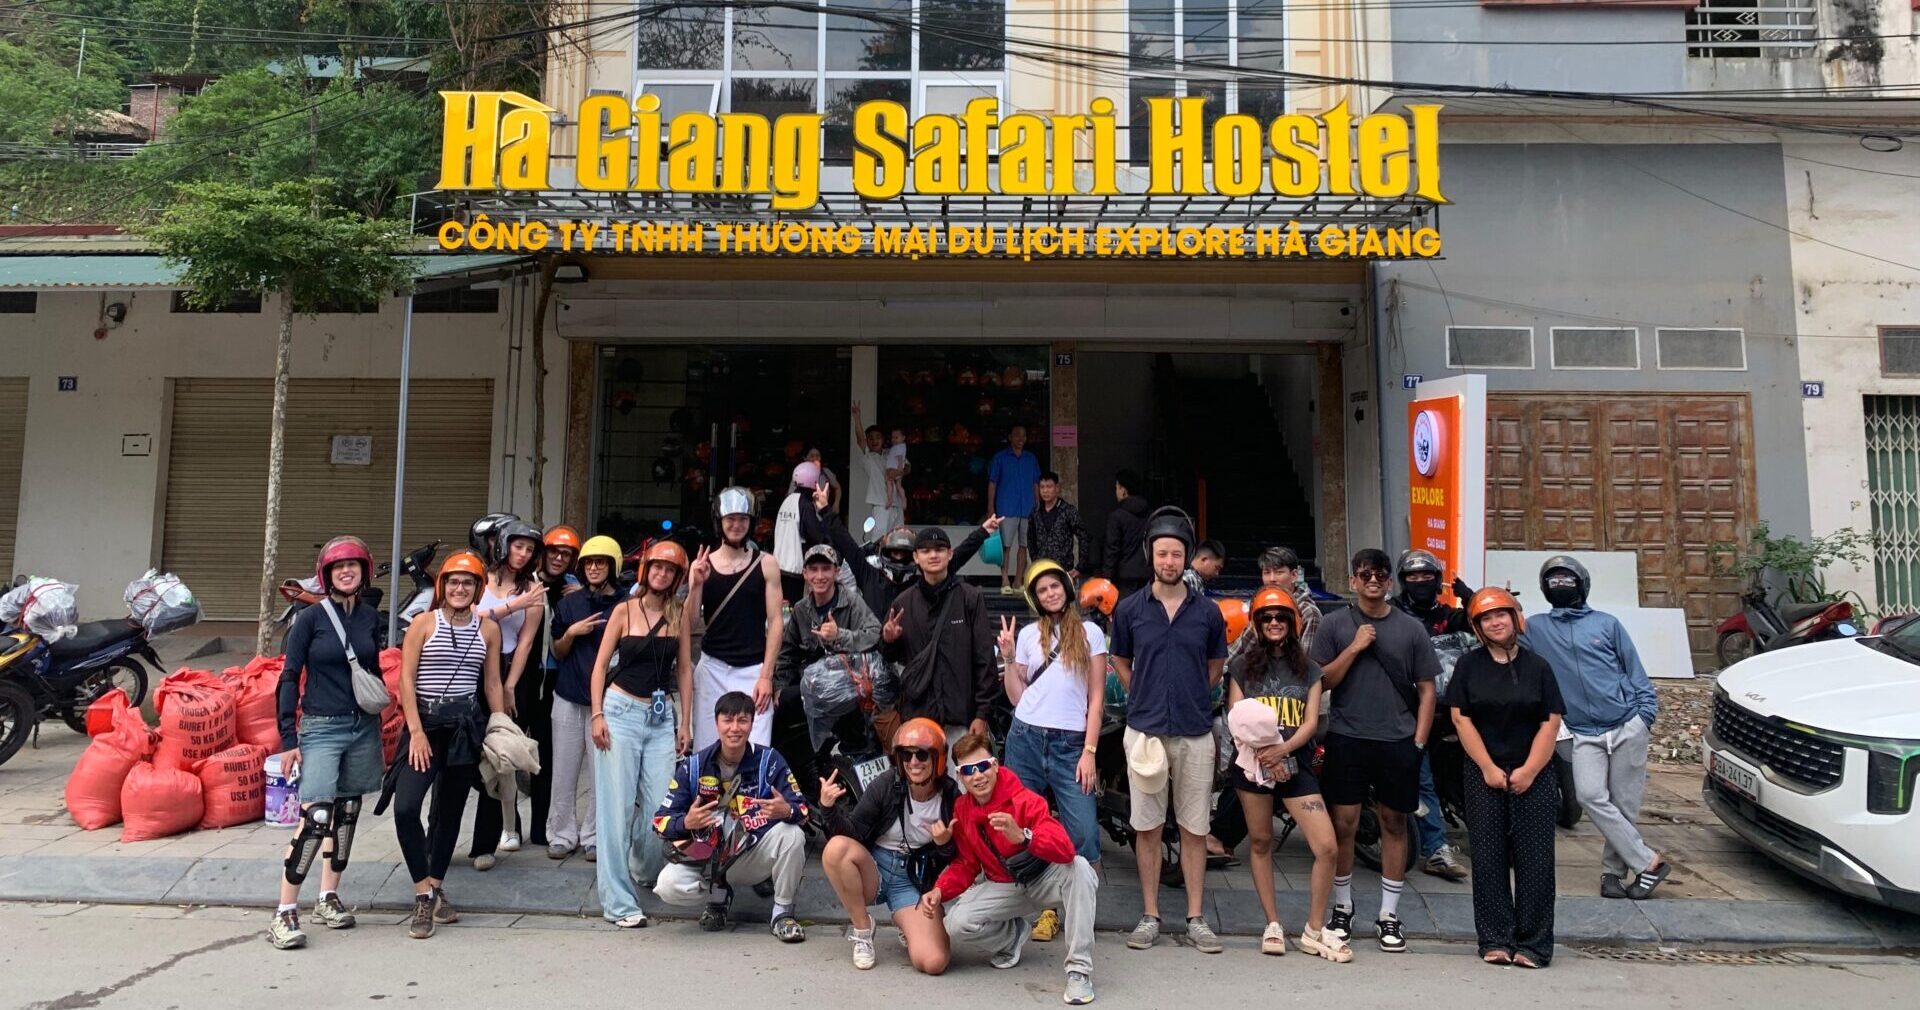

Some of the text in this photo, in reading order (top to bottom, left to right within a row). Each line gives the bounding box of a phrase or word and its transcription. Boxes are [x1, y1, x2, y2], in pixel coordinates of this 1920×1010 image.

[576, 93, 830, 211] Giang
[852, 97, 1122, 200] Safari
[1143, 94, 1456, 205] Hostel
[438, 213, 549, 251] CÔNG
[559, 223, 600, 252] TY
[612, 223, 704, 253] TNHH
[715, 220, 863, 255] THƯƠNG
[873, 226, 938, 261] MẠI
[948, 226, 995, 255] DU
[1006, 226, 1085, 262] LỊCH
[1096, 227, 1246, 257] EXPLORE
[1256, 220, 1308, 257] HÀ
[1318, 227, 1442, 258] GIANG
[1058, 354, 1071, 365] 75
[61, 379, 74, 390] 73
[1406, 376, 1420, 388] 77
[1805, 383, 1820, 396] 79
[1411, 486, 1444, 507] EXPLORE
[191, 736, 201, 746] 50
[203, 734, 214, 745] KG
[182, 747, 198, 759] USE
[224, 760, 251, 773] BIURET
[237, 772, 259, 786] 50 KG
[231, 790, 247, 802] USE
